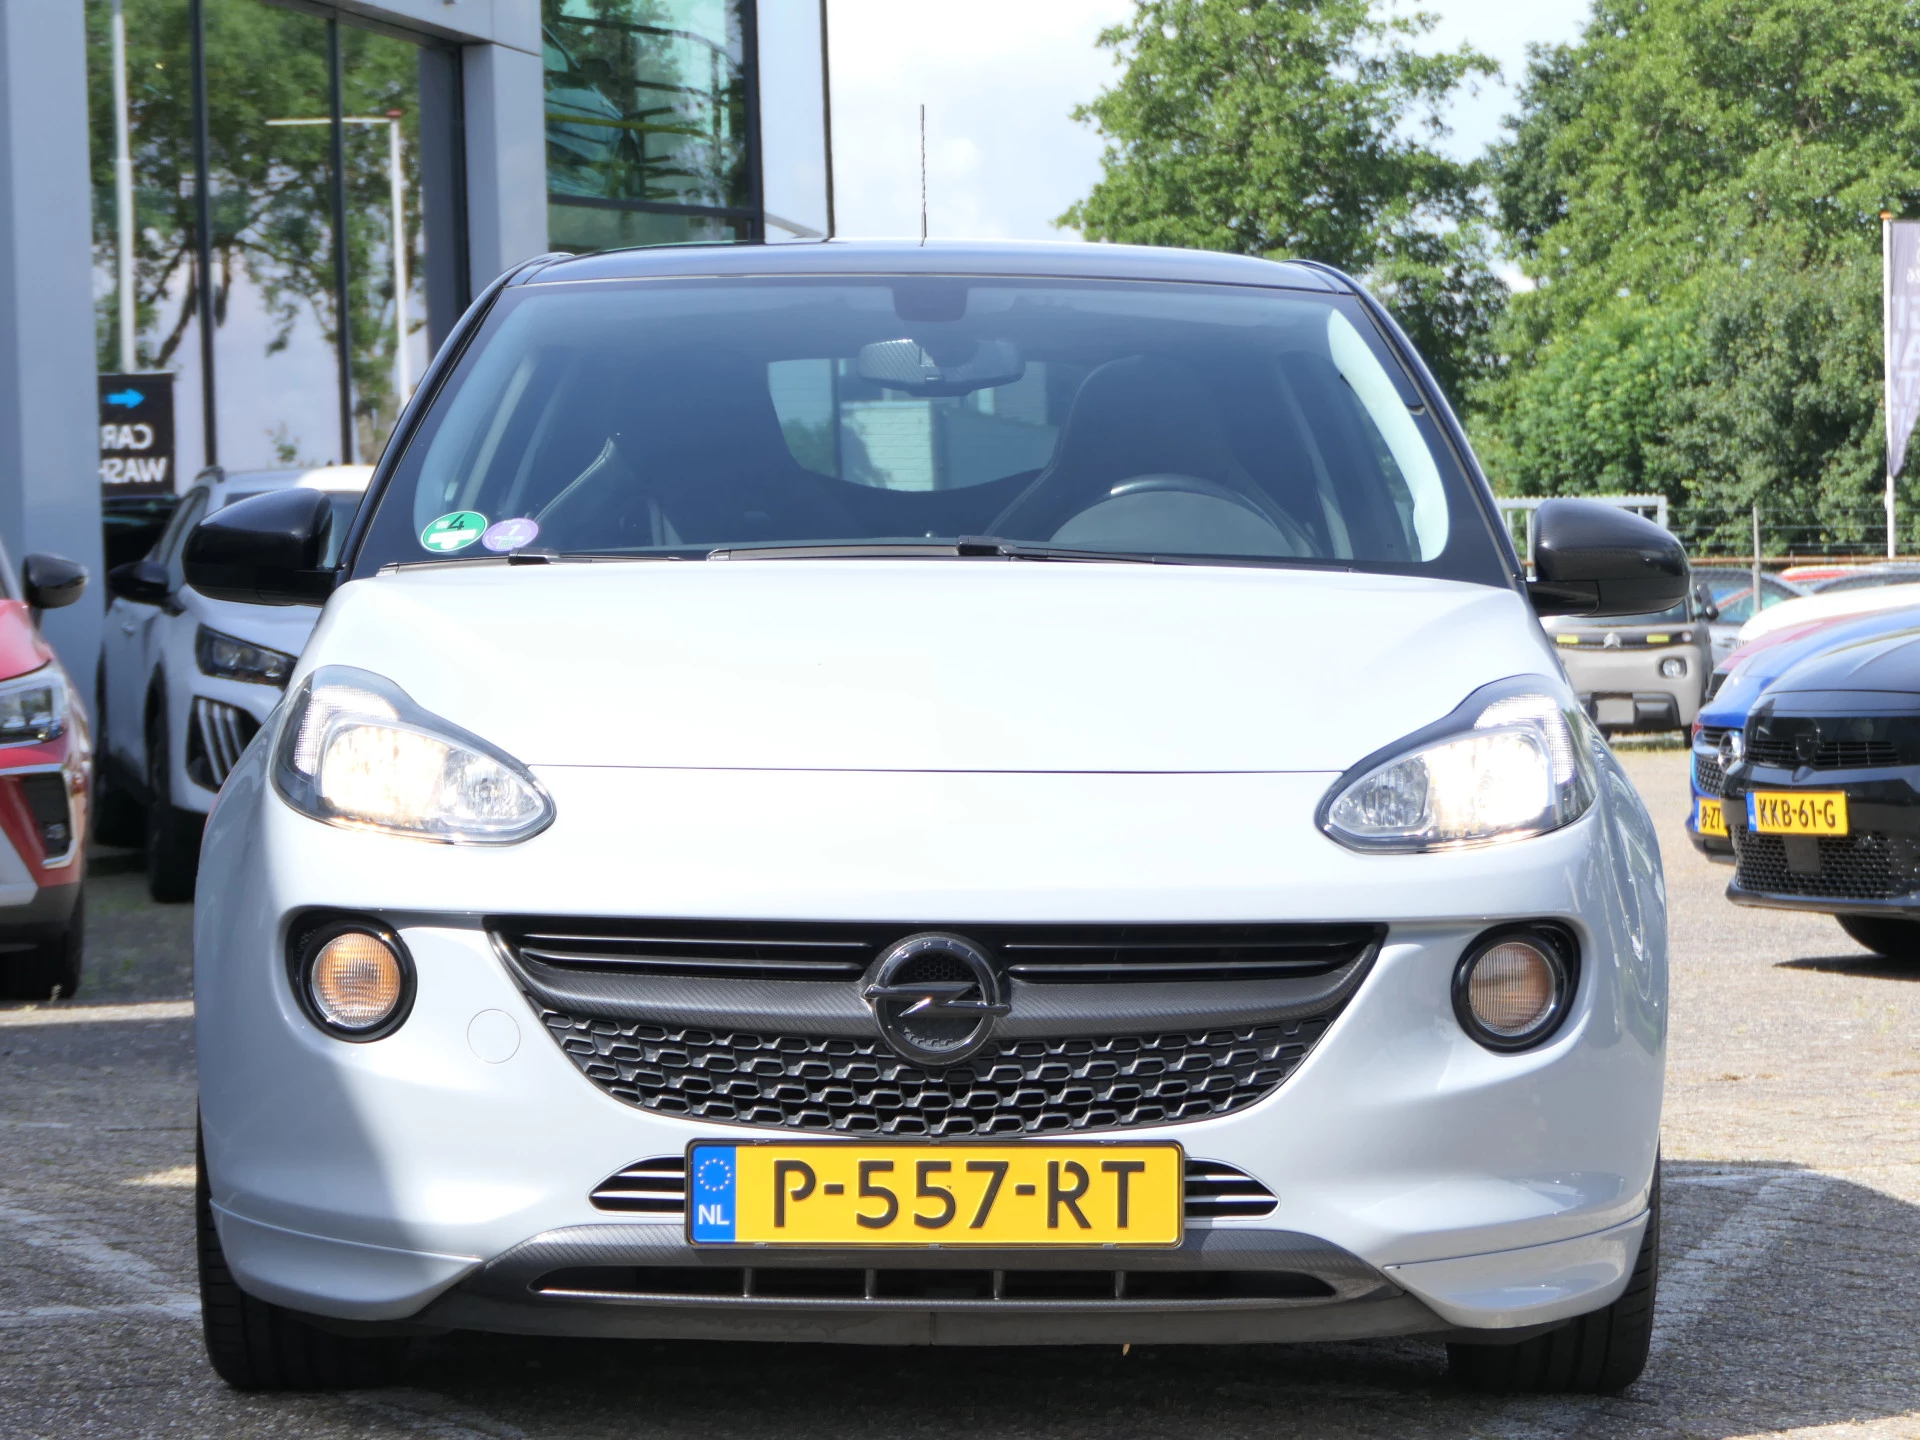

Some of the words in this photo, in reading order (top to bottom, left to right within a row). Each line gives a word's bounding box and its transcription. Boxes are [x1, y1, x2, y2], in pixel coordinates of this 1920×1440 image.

[447, 513, 465, 531] 4
[1758, 798, 1836, 829] KKB-61-G
[773, 1160, 1145, 1229] P-557-RT
[698, 1204, 730, 1226] NL
